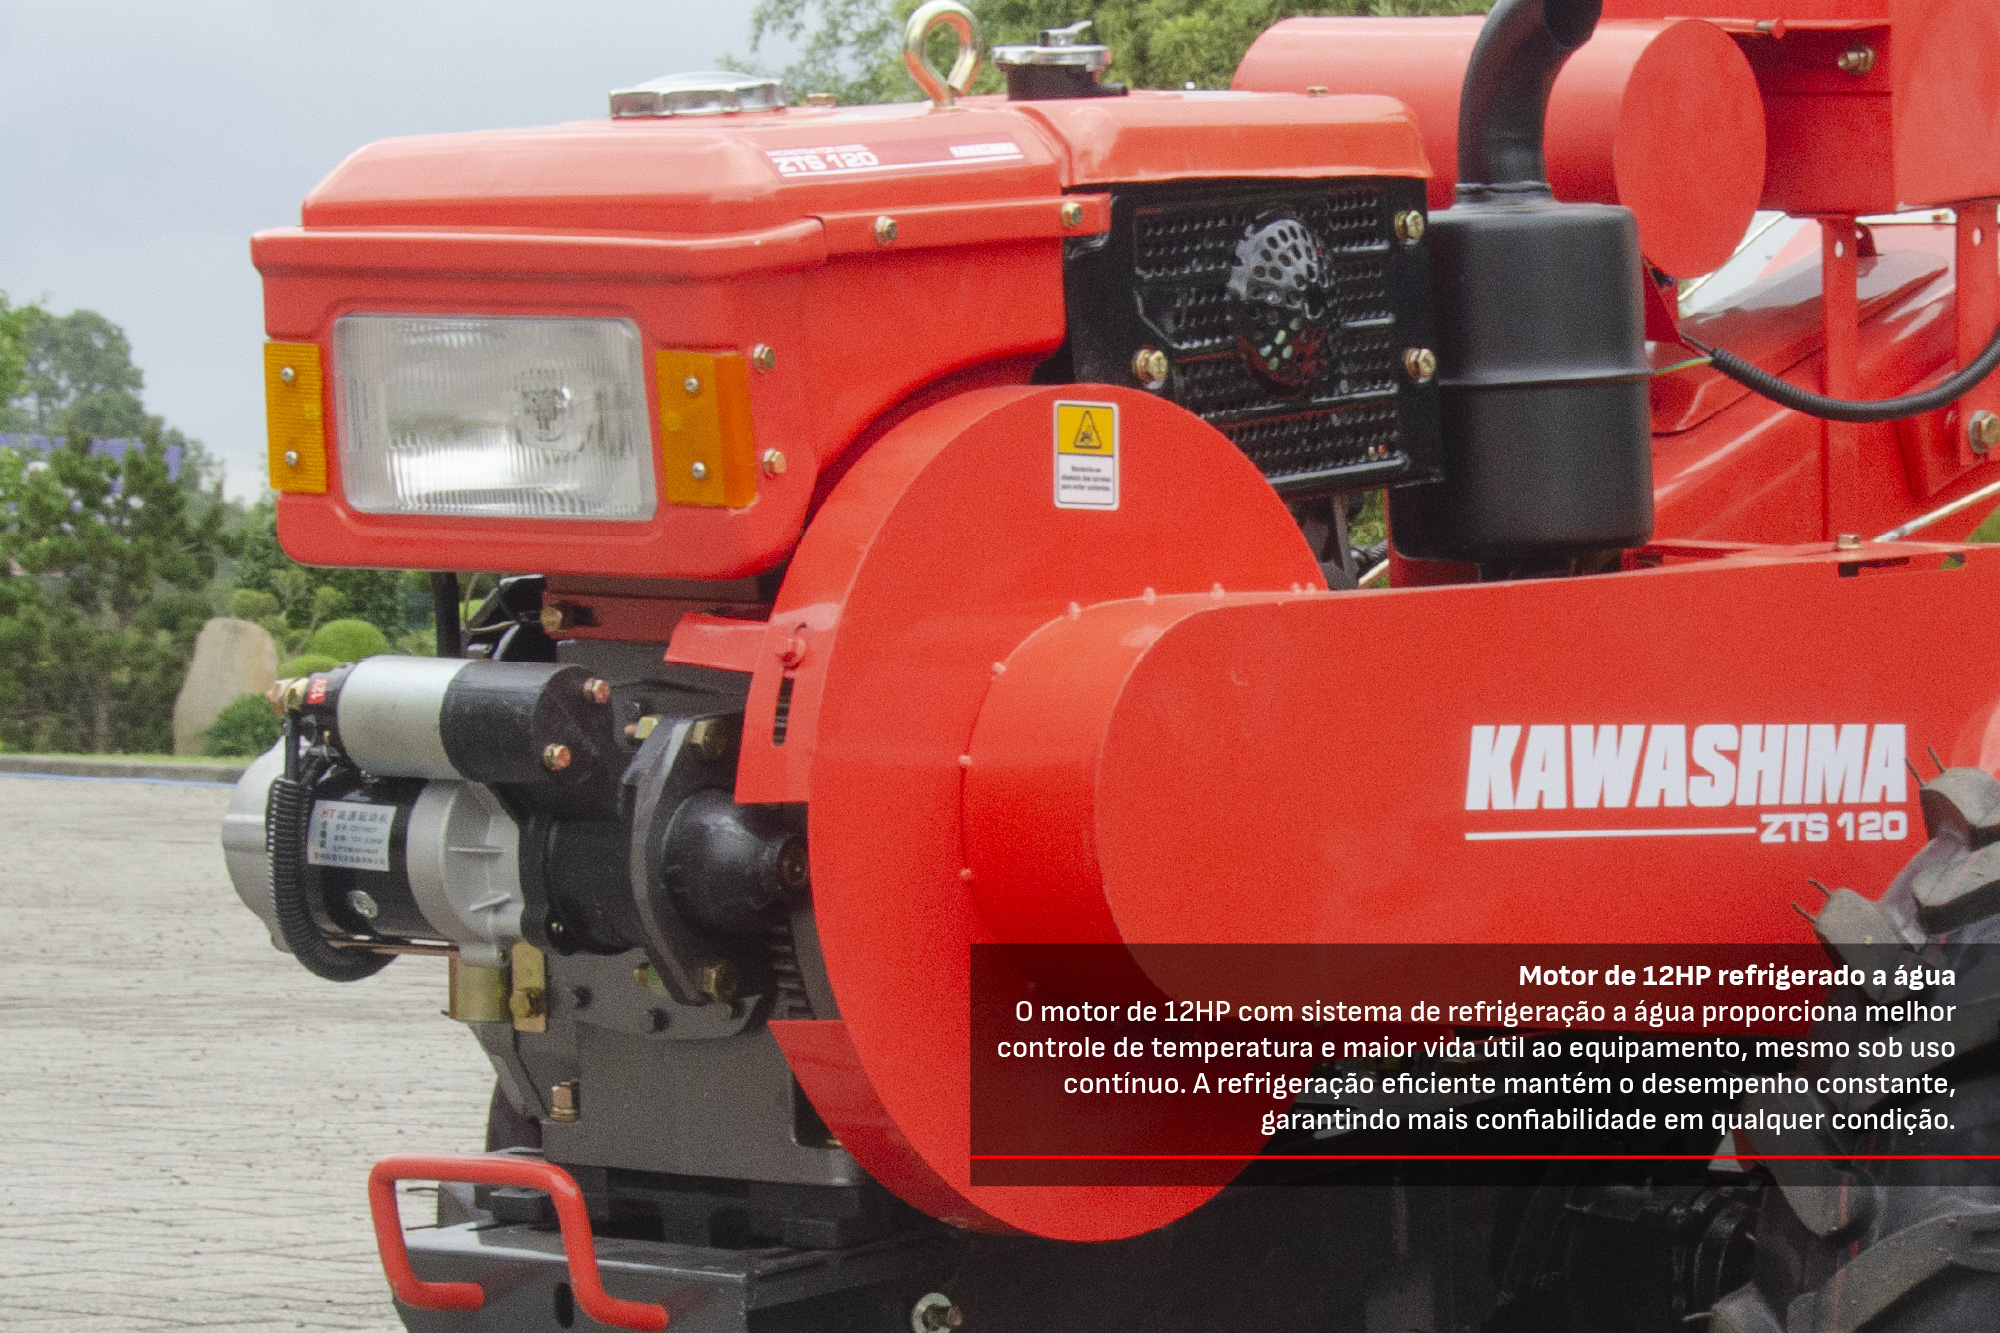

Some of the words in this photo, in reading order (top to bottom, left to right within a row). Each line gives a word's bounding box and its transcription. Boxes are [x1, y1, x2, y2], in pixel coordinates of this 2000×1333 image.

[771, 154, 827, 173] ZTS
[826, 151, 879, 168] 120
[1465, 724, 1907, 810] KAWASHIMA
[1760, 812, 1829, 843] ZTS
[1837, 810, 1908, 841] 120
